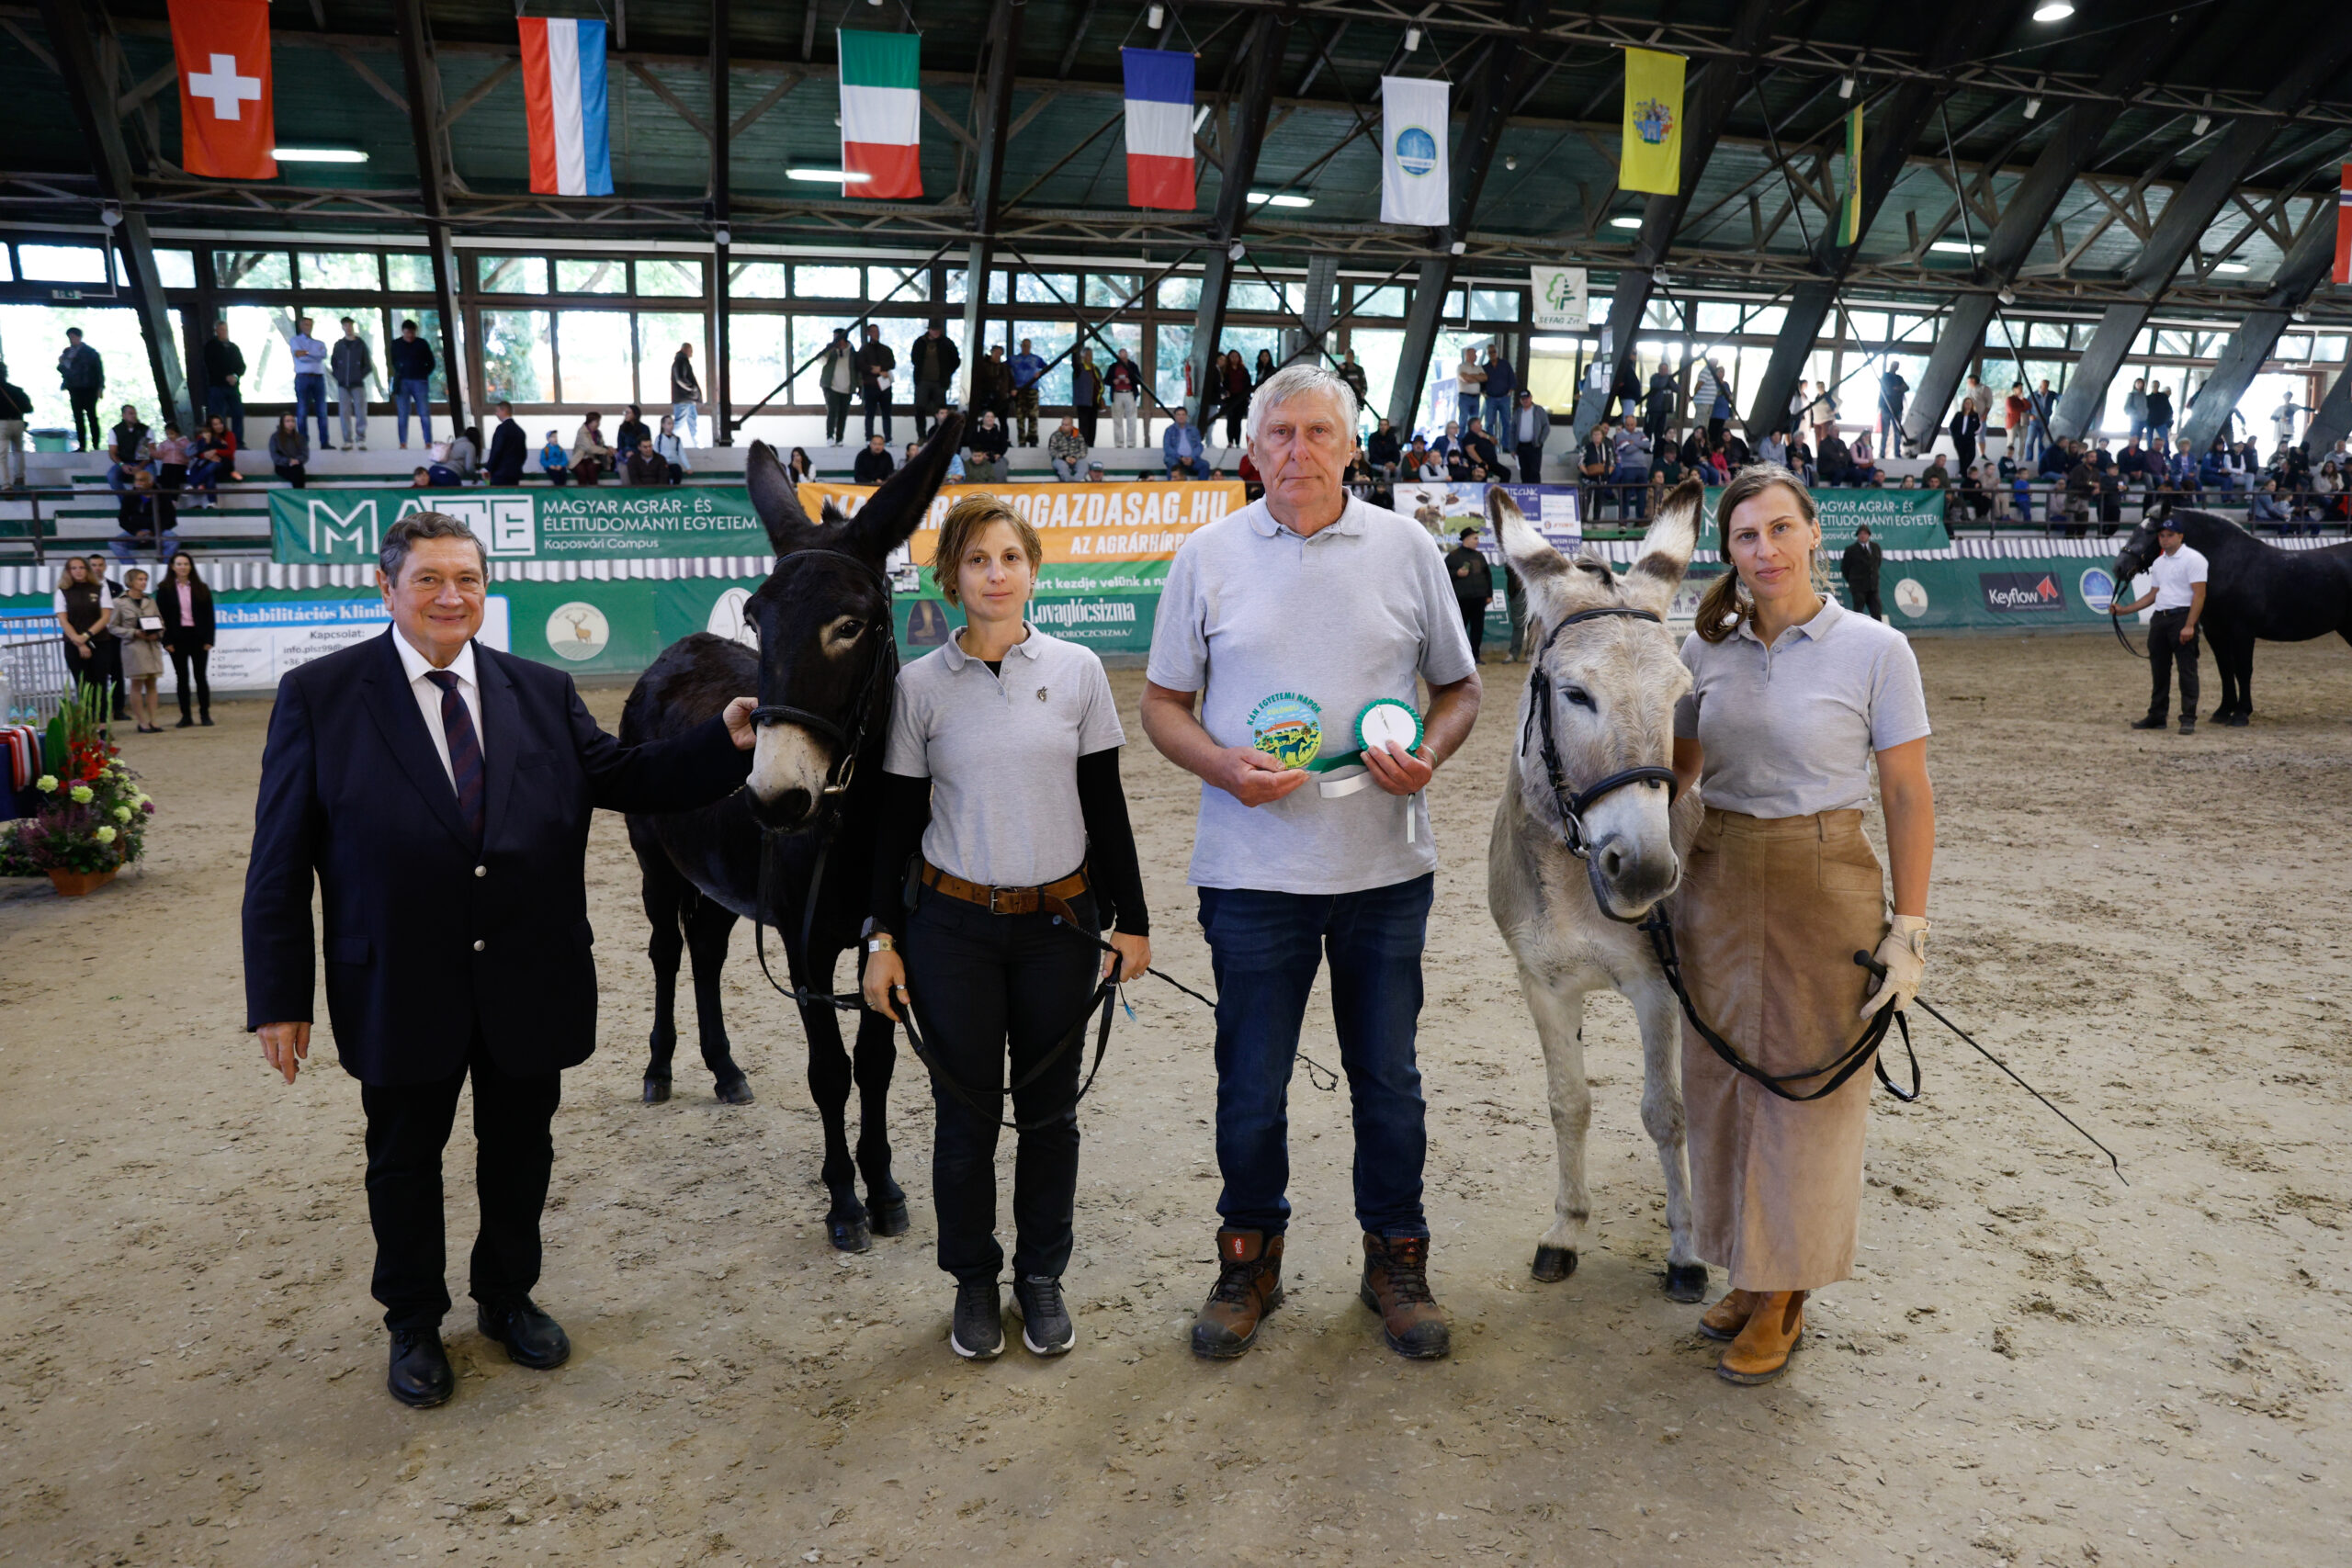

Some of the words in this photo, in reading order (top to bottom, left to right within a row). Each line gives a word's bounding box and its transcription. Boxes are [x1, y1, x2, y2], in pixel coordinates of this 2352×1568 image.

[1538, 316, 1565, 324] SEFAG
[542, 500, 618, 514] MAGYAR
[622, 498, 689, 514] AGRÁR-
[694, 497, 712, 513] ÉS
[1858, 499, 1899, 513] AGRÁR-
[1903, 499, 1914, 513] ÉS
[543, 515, 679, 532] ÉLETTUDOMÁNYI
[683, 515, 758, 531] EGYETEM
[1819, 513, 1893, 526] ETTUDOMÁNYI
[544, 537, 605, 551] Kaposvári
[607, 537, 660, 550] Campus
[1070, 536, 1091, 555] AZ
[1094, 530, 1192, 555] AGRÁRHÍRP
[1055, 576, 1097, 592] kezdje
[1100, 575, 1140, 589] velünk
[1143, 577, 1151, 587] a
[1988, 587, 2039, 608] Keyflow
[215, 605, 337, 624] Rehabilitációs
[1027, 597, 1136, 627] Lovaglócsizma
[310, 629, 366, 641] Kapcsolat:
[1258, 692, 1295, 710] EGYETEMI
[1296, 694, 1322, 714] NAPOK
